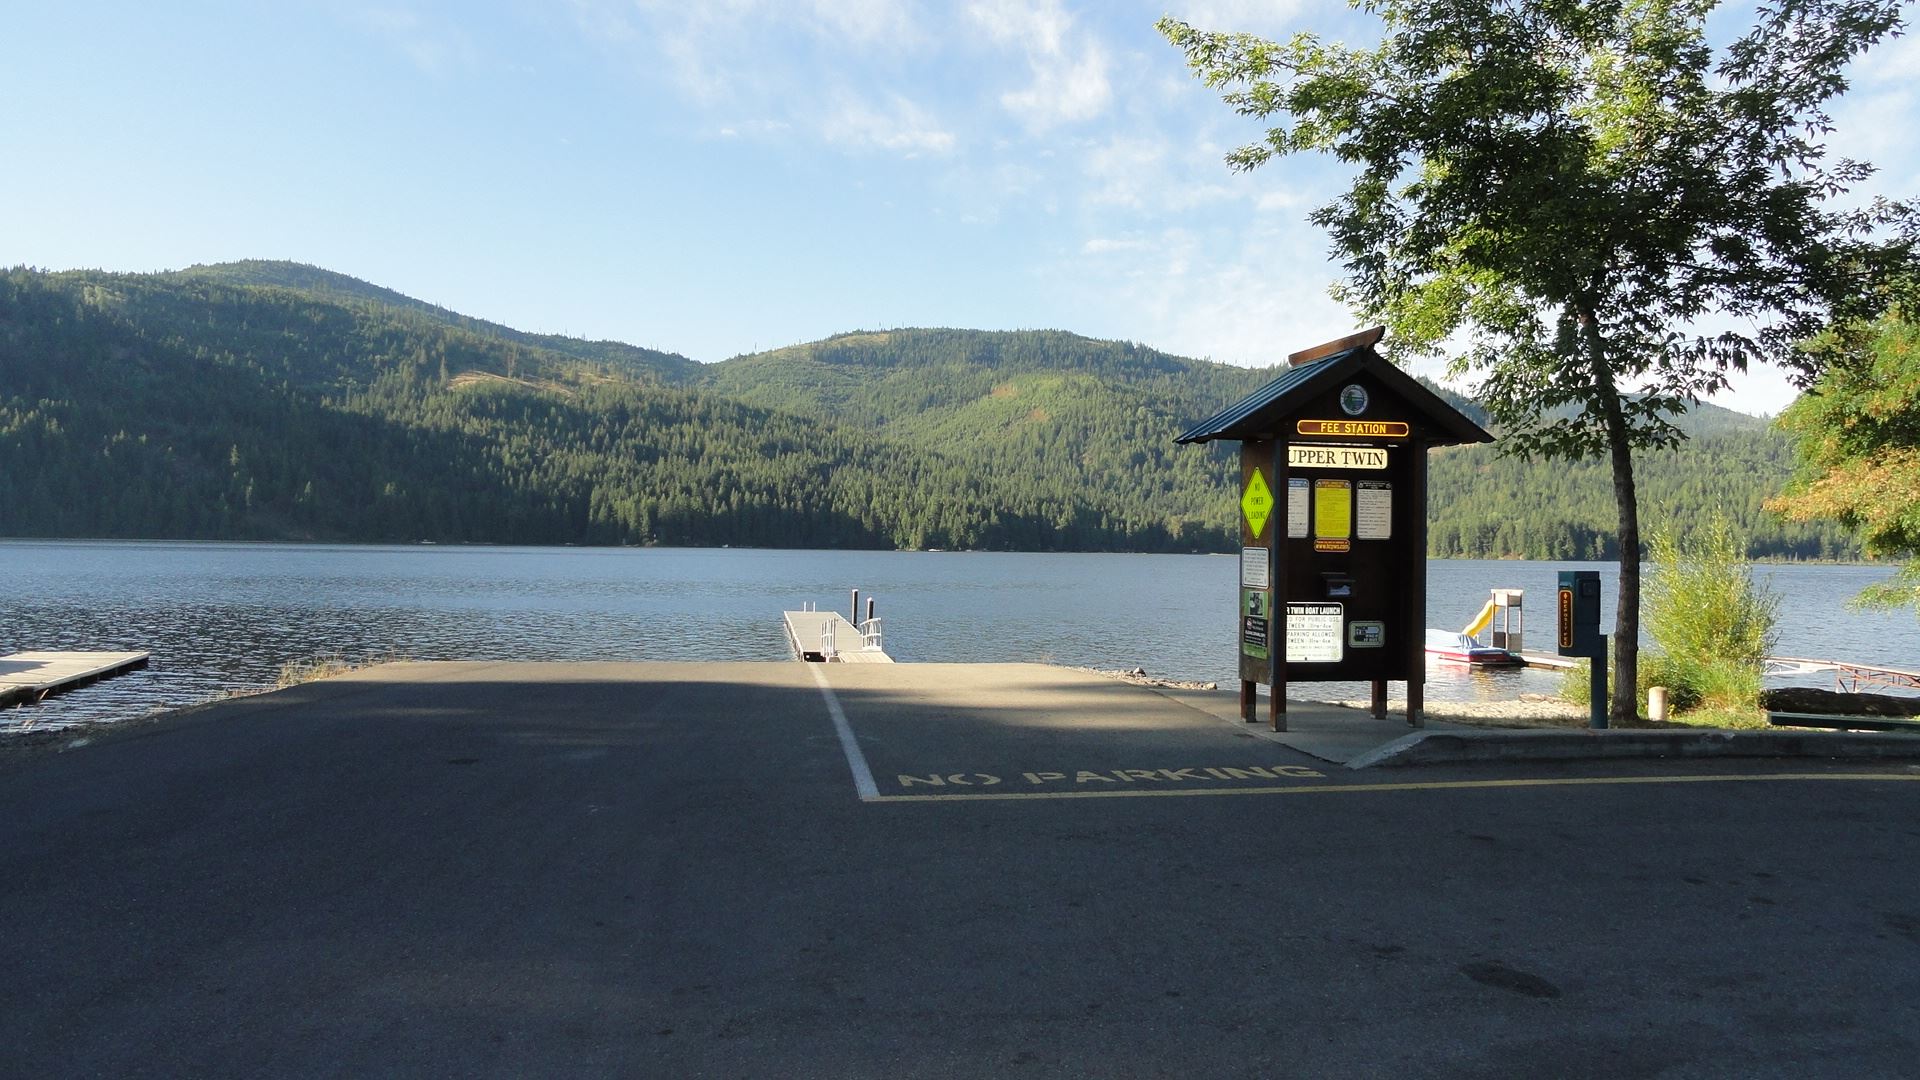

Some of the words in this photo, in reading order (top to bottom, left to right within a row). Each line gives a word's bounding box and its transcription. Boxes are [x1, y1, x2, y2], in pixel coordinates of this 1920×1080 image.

[1320, 423, 1340, 433] FEE
[1344, 424, 1387, 434] STATION
[1288, 450, 1337, 465] UPPER
[1342, 451, 1384, 465] TWIN
[897, 773, 1001, 787] NO
[1023, 765, 1327, 785] PARKING
